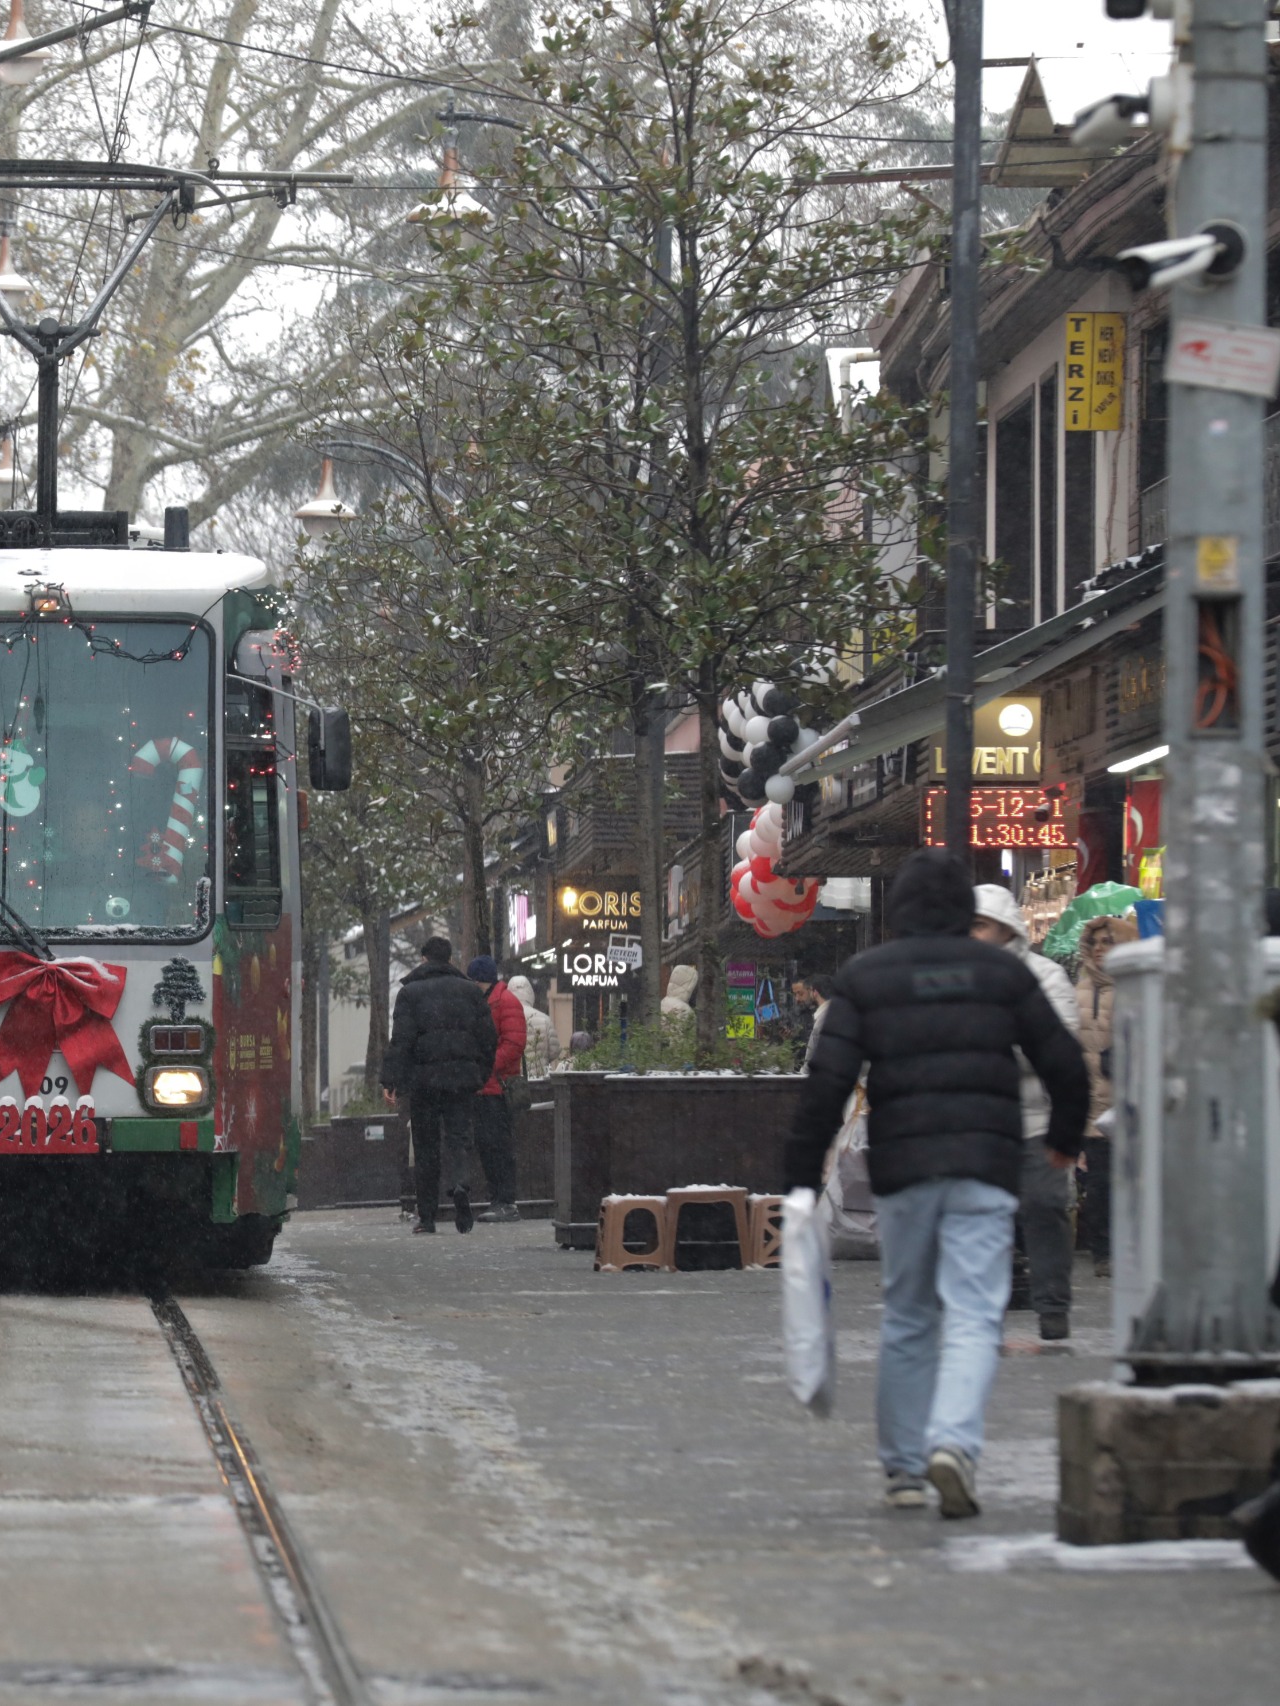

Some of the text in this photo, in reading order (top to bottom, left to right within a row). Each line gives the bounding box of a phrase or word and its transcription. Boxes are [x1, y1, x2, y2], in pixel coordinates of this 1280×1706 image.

[935, 746, 1029, 775] LVENT
[583, 919, 628, 930] PARFUM
[571, 974, 618, 986] PARFUM
